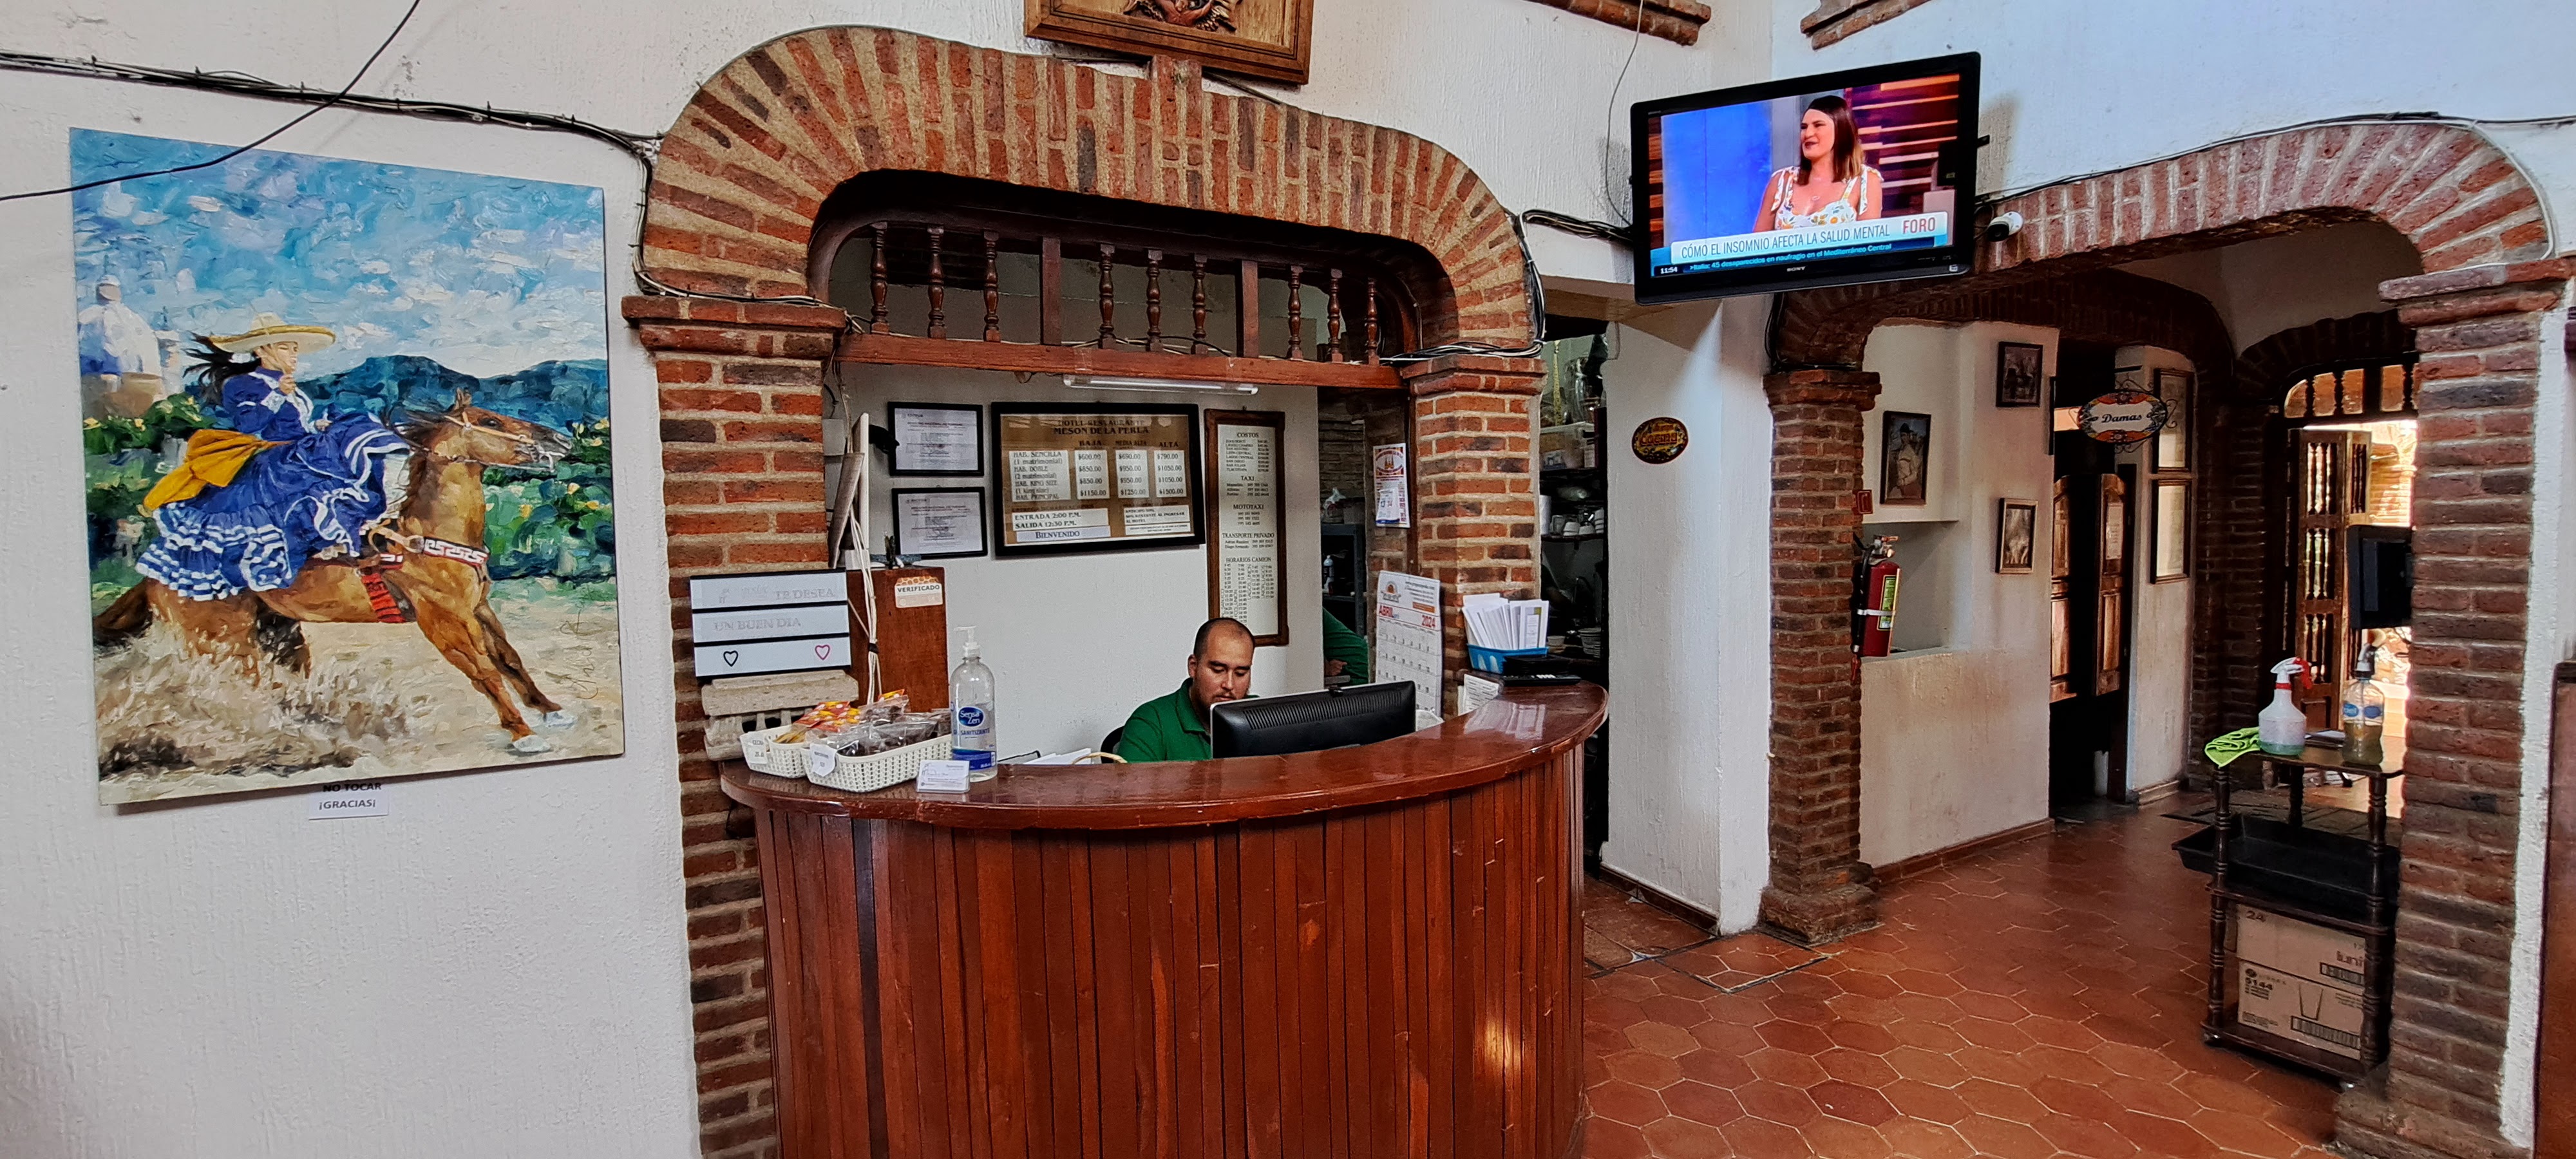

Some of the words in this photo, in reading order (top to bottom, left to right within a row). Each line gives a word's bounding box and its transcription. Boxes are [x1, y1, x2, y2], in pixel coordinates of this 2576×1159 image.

[1903, 217, 1935, 234] FORO
[1681, 243, 1707, 259] CÓMO
[1711, 243, 1720, 256] EL
[1723, 238, 1770, 254] INSOMNIO
[1772, 232, 1803, 249] AFECTA
[1807, 232, 1817, 245] LA
[1820, 229, 1850, 243] SALUD
[1853, 225, 1890, 240] MENTAL
[1721, 257, 1765, 267] desaparecidos
[1776, 252, 1806, 261] naufragio
[1824, 246, 1866, 256] Mediterráneo
[1868, 243, 1892, 252] Central
[2101, 413, 2142, 423] Damas
[1035, 531, 1080, 539] BIENVENIDO
[774, 590, 790, 600] TE
[792, 588, 835, 599] DESEA
[714, 621, 734, 631] UN
[737, 618, 773, 630] BUEN
[777, 617, 801, 628] DIA
[960, 710, 980, 719] Sensa
[344, 782, 382, 791] TOCAR
[2246, 910, 2266, 923] 24
